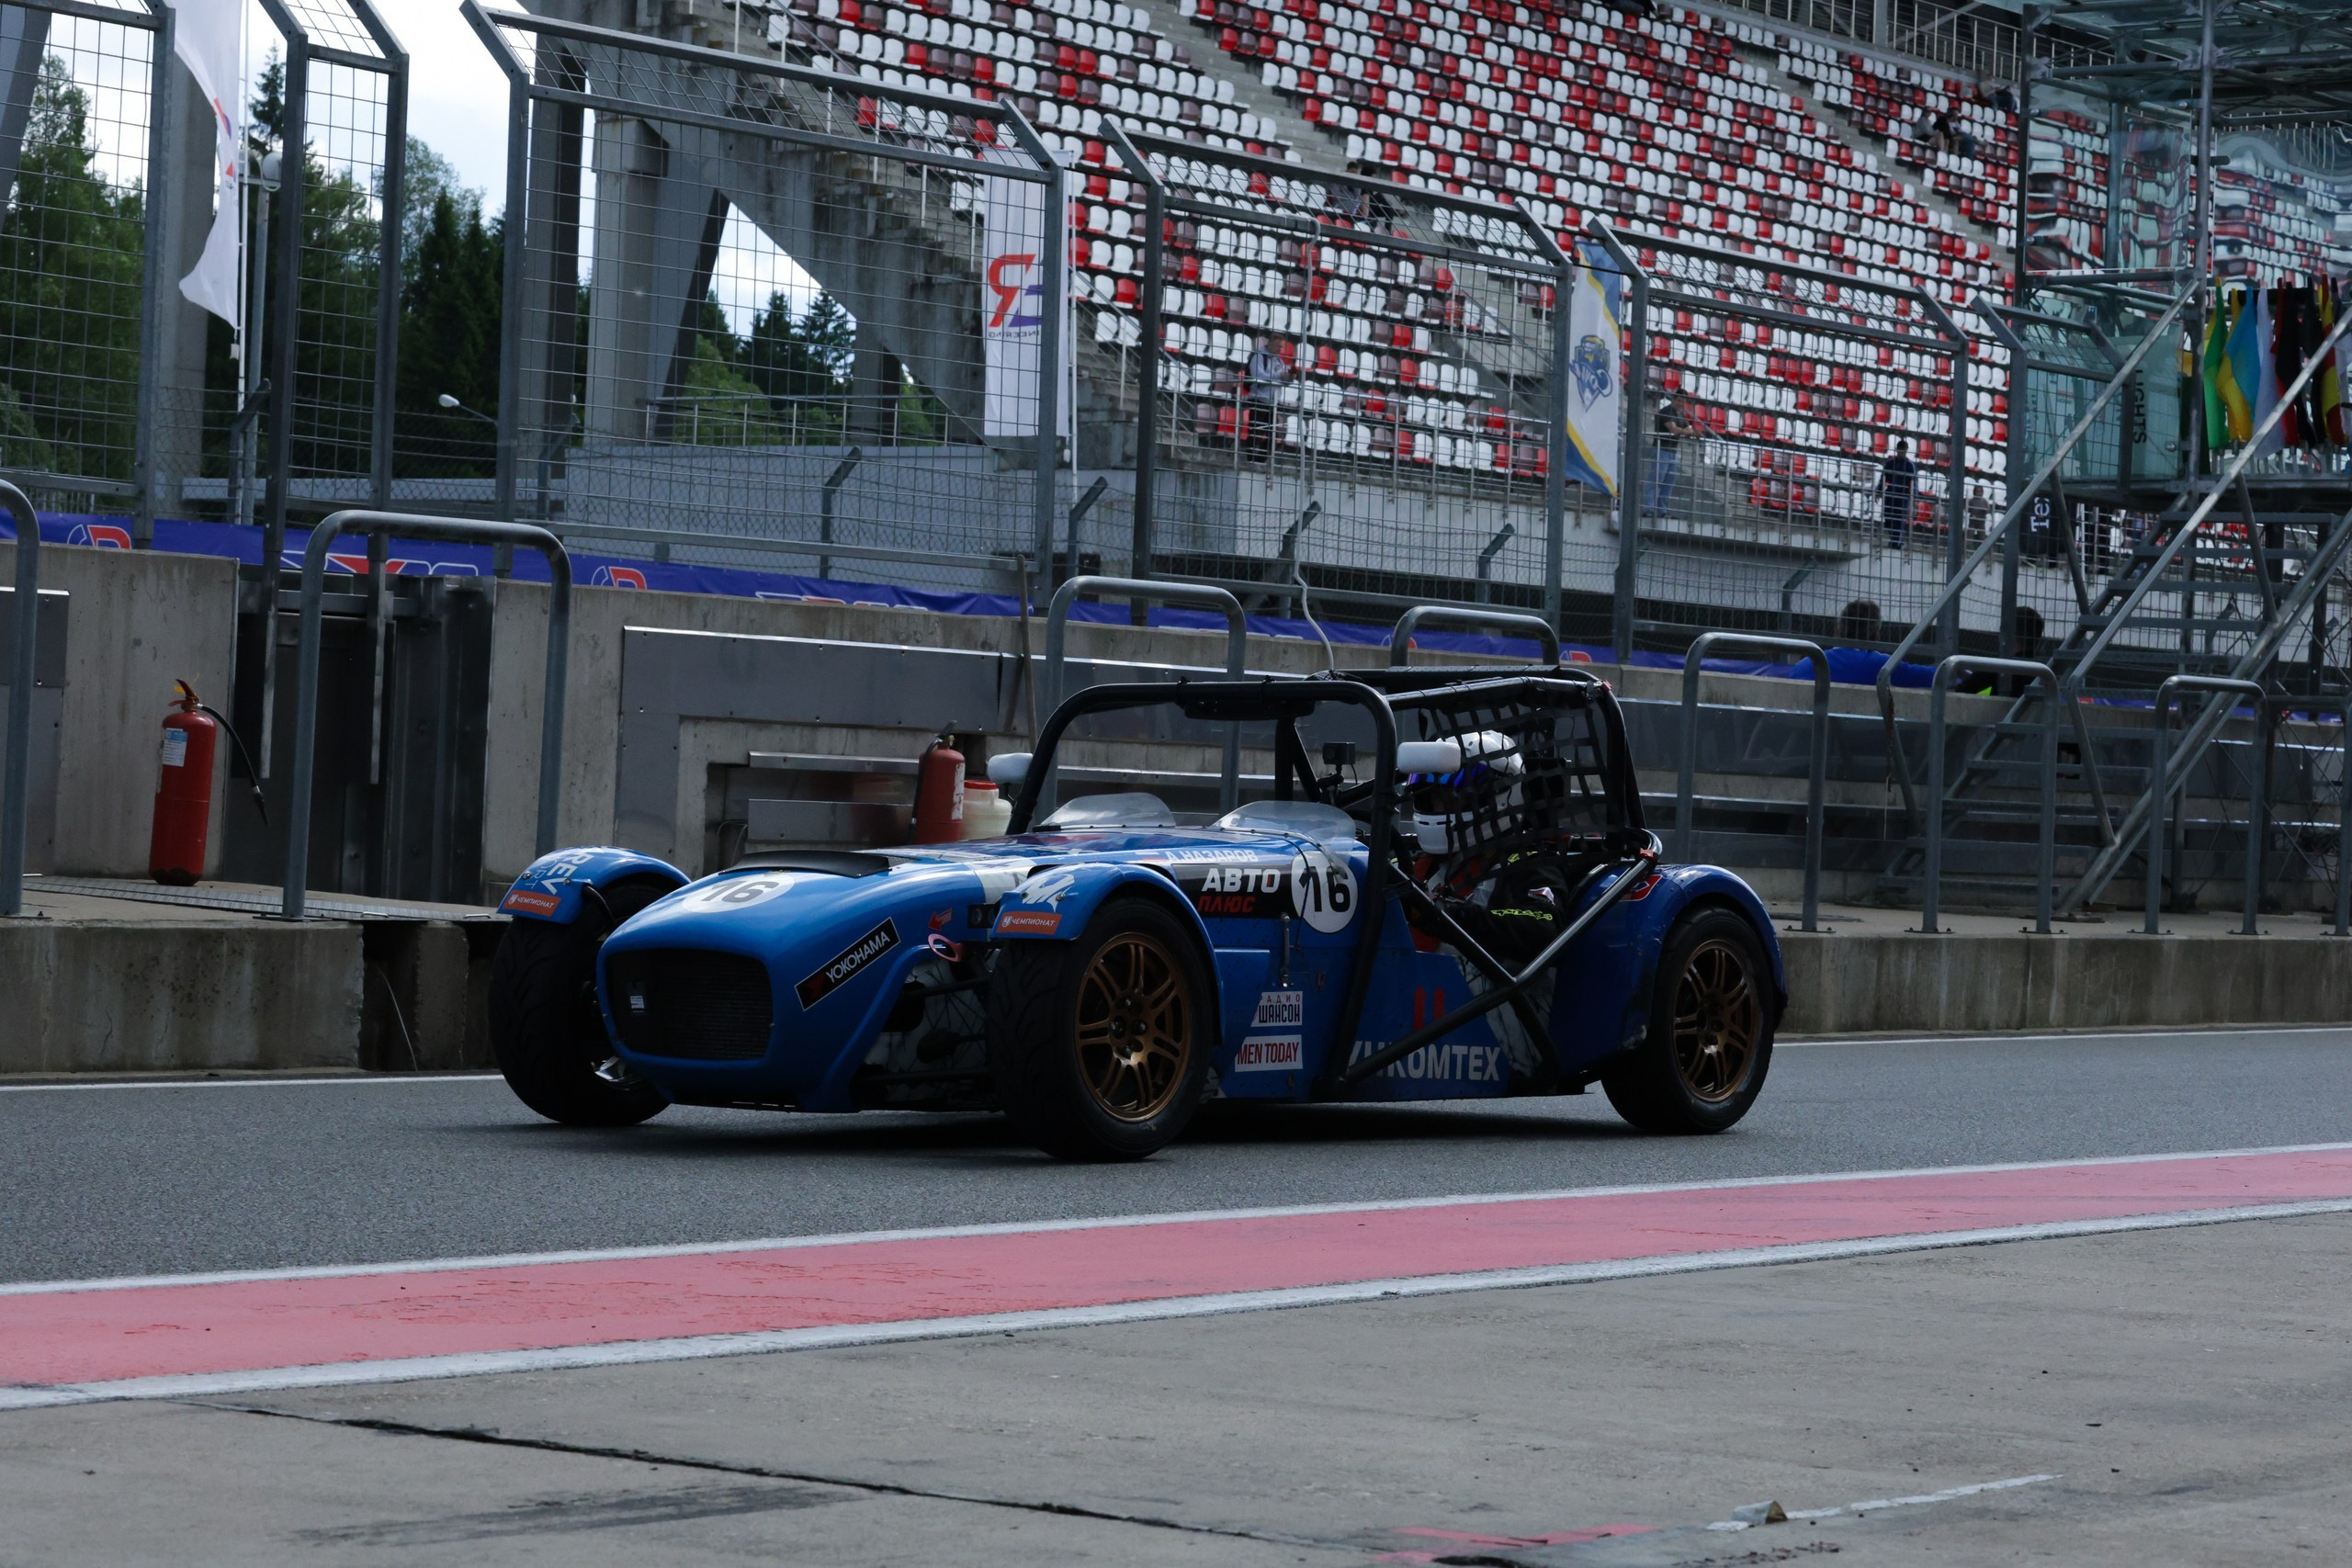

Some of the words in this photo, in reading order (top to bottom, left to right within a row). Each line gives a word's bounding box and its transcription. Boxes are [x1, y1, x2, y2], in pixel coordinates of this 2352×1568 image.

[701, 880, 780, 903] 16
[1201, 867, 1281, 894] АВТО
[1299, 865, 1351, 912] 16
[516, 896, 555, 909] ЧЕМПИОНАТ
[1197, 895, 1257, 913] ПЛЮС
[1012, 918, 1056, 927] ЧЕМПИОНАТ
[825, 931, 891, 984] YOKOHAMA
[1259, 1004, 1301, 1023] ШАНСОН
[1238, 1043, 1262, 1065] MEN
[1264, 1042, 1300, 1064] TODAY
